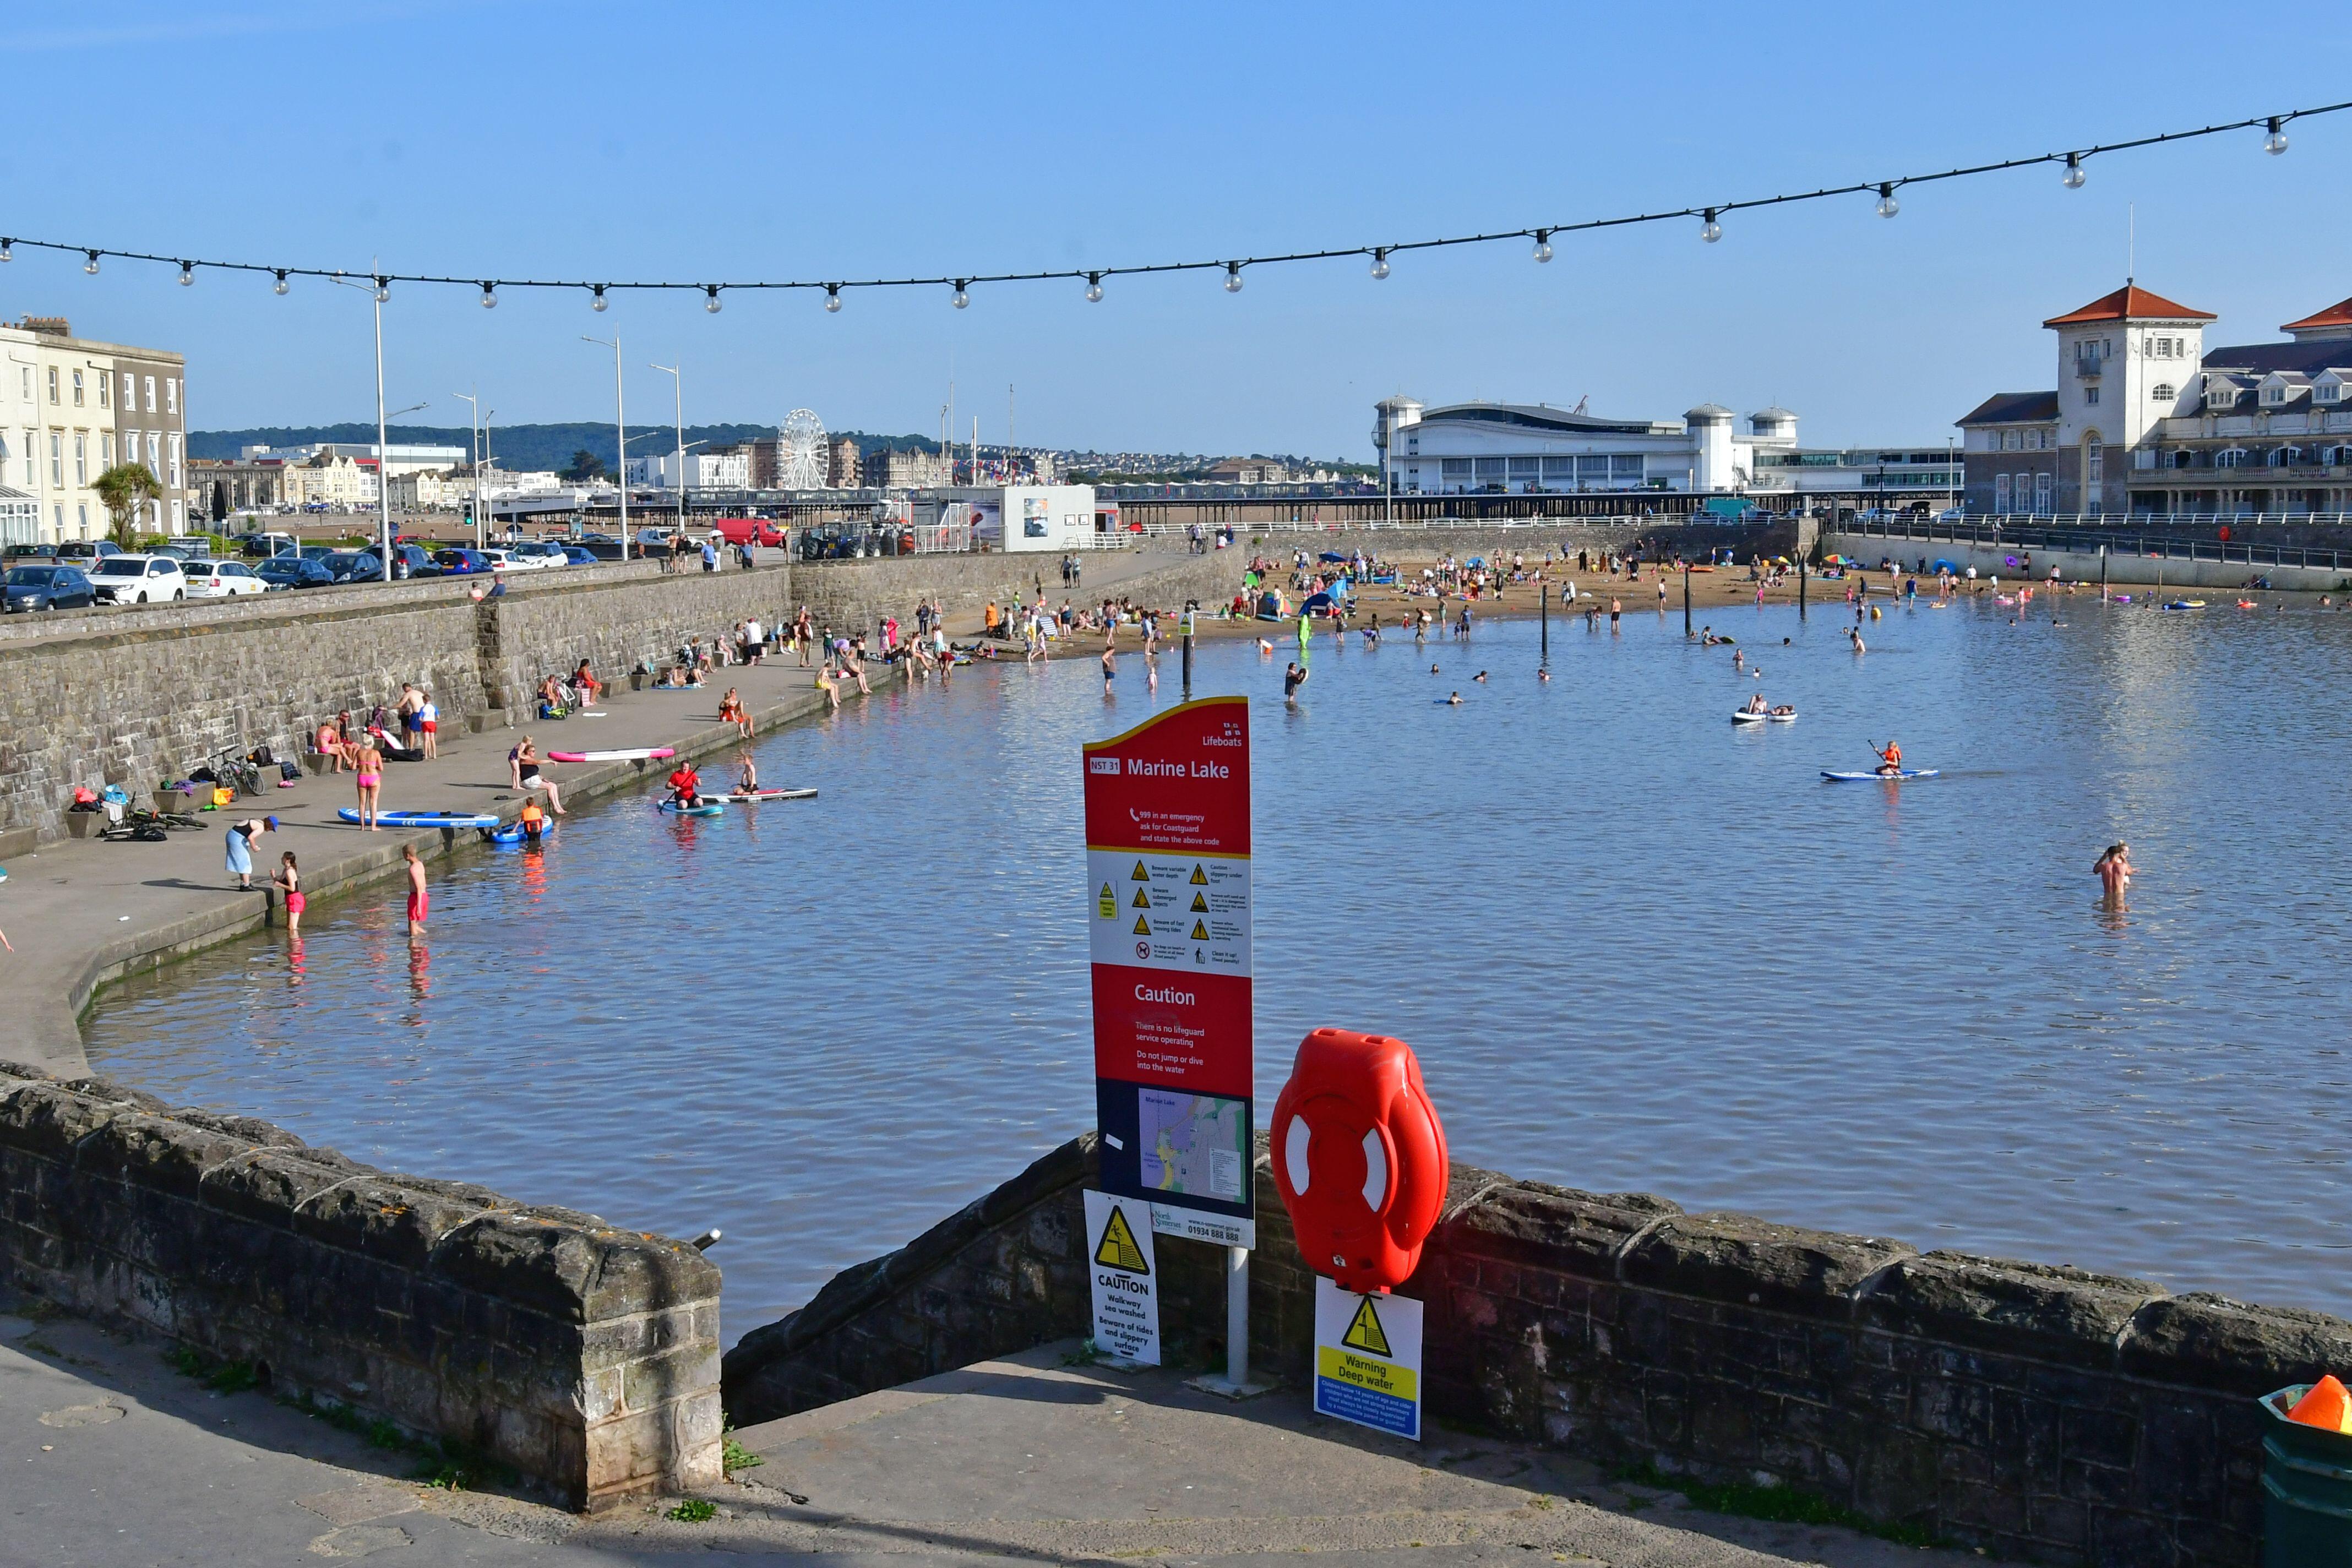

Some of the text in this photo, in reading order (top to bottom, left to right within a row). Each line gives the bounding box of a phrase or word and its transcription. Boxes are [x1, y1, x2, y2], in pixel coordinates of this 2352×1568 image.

[1202, 736, 1242, 747] Lifeboats
[1091, 761, 1119, 771] NST 31
[1128, 759, 1229, 778] Marine Lake
[1169, 814, 1205, 823] emergency
[1163, 824, 1199, 834] Coastguard
[1204, 837, 1220, 846] code
[1135, 984, 1195, 1005] Caution
[1135, 1021, 1155, 1031] There
[1174, 1025, 1205, 1037] lifeguard
[1136, 1033, 1194, 1048] service operating
[1137, 1050, 1146, 1058] Do
[1161, 1053, 1179, 1064] jump
[1189, 1056, 1204, 1065] dive
[1165, 1066, 1185, 1074] water
[1155, 1210, 1171, 1220] North
[1155, 1218, 1182, 1228] Somerset
[1188, 1226, 1209, 1236] 01934
[1211, 1229, 1224, 1239] 888
[1226, 1232, 1239, 1242] 888
[1098, 1275, 1148, 1295] CAUTION
[1107, 1294, 1141, 1310] Walkway
[1104, 1305, 1146, 1320] sea washed
[1099, 1316, 1153, 1336] Beware of tides
[1104, 1329, 1148, 1346] and slippery
[1114, 1341, 1139, 1352] surface
[1346, 1354, 1386, 1378] Warning
[1321, 1380, 1340, 1390] Children
[1338, 1365, 1394, 1390] Deep water
[1325, 1389, 1342, 1397] children
[1386, 1406, 1409, 1416] swimmers
[1337, 1405, 1363, 1416] responsible
[1385, 1419, 1406, 1428] guardian
[1340, 1400, 1355, 1408] always
[1363, 1406, 1379, 1415] closely
[1380, 1411, 1406, 1422] supervised
